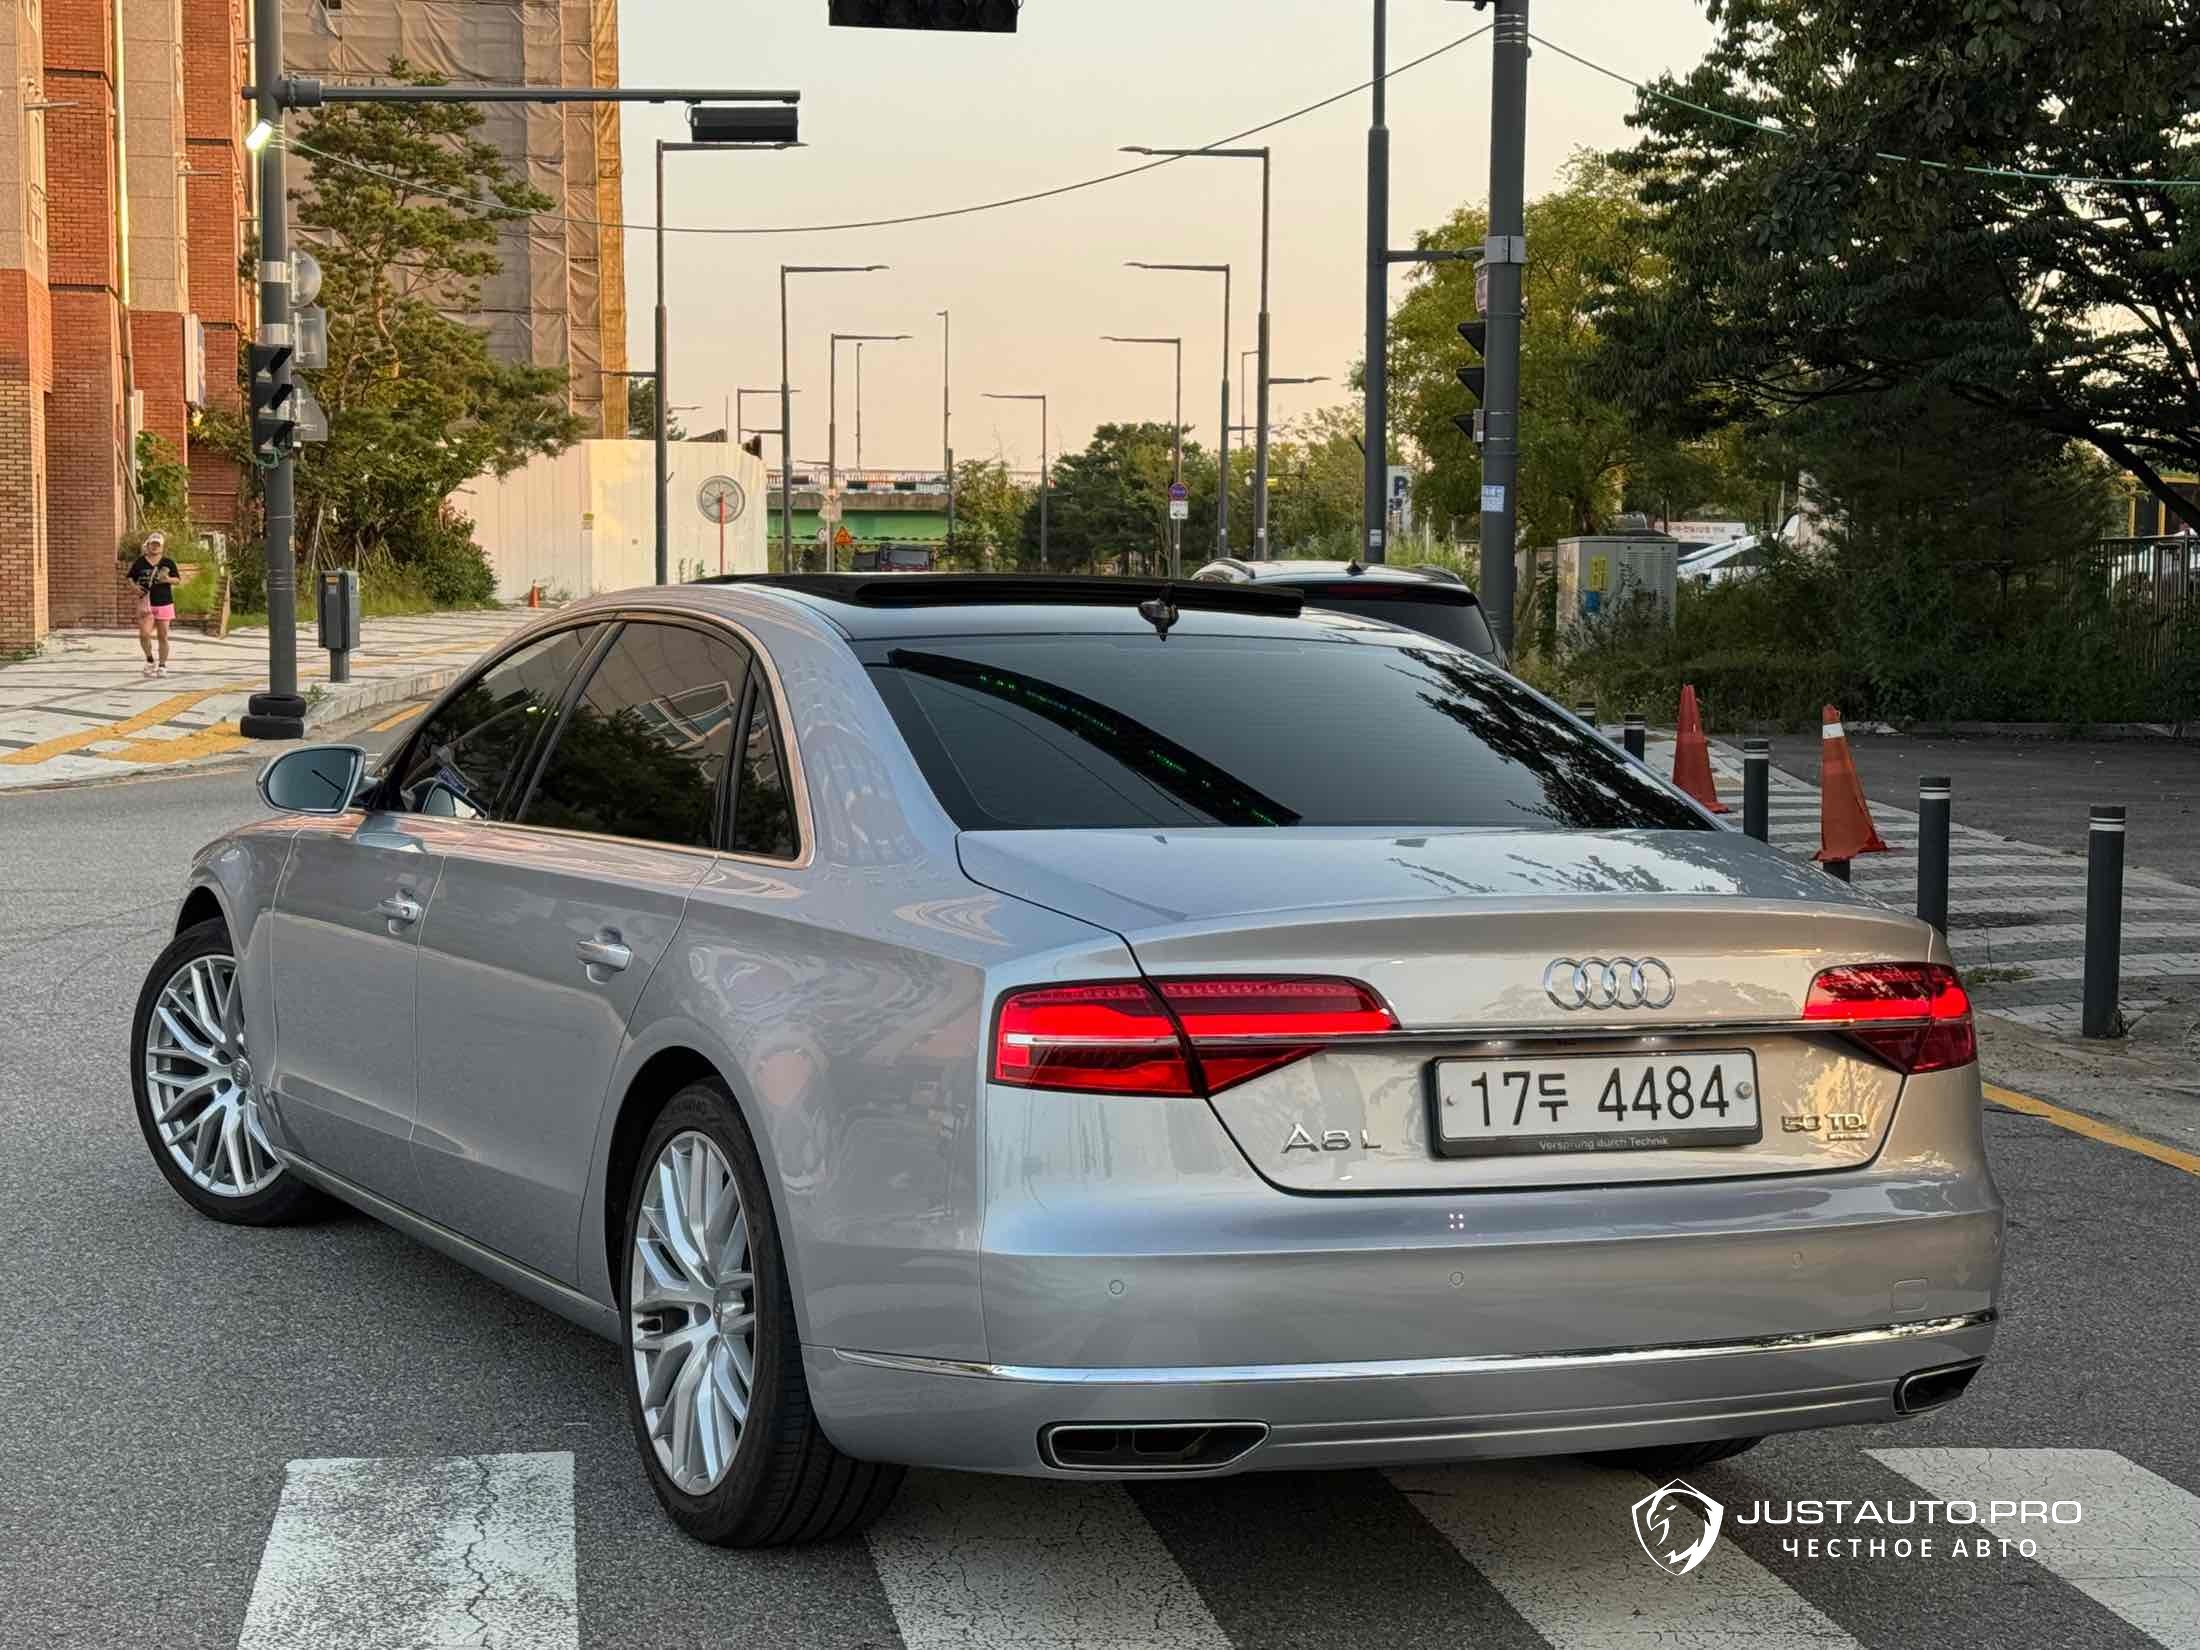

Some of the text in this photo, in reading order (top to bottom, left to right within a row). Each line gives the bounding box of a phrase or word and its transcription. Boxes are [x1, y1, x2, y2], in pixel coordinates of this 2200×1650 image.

[1471, 1064, 1729, 1127] 17두 4484
[1630, 1134, 1670, 1147] Technik
